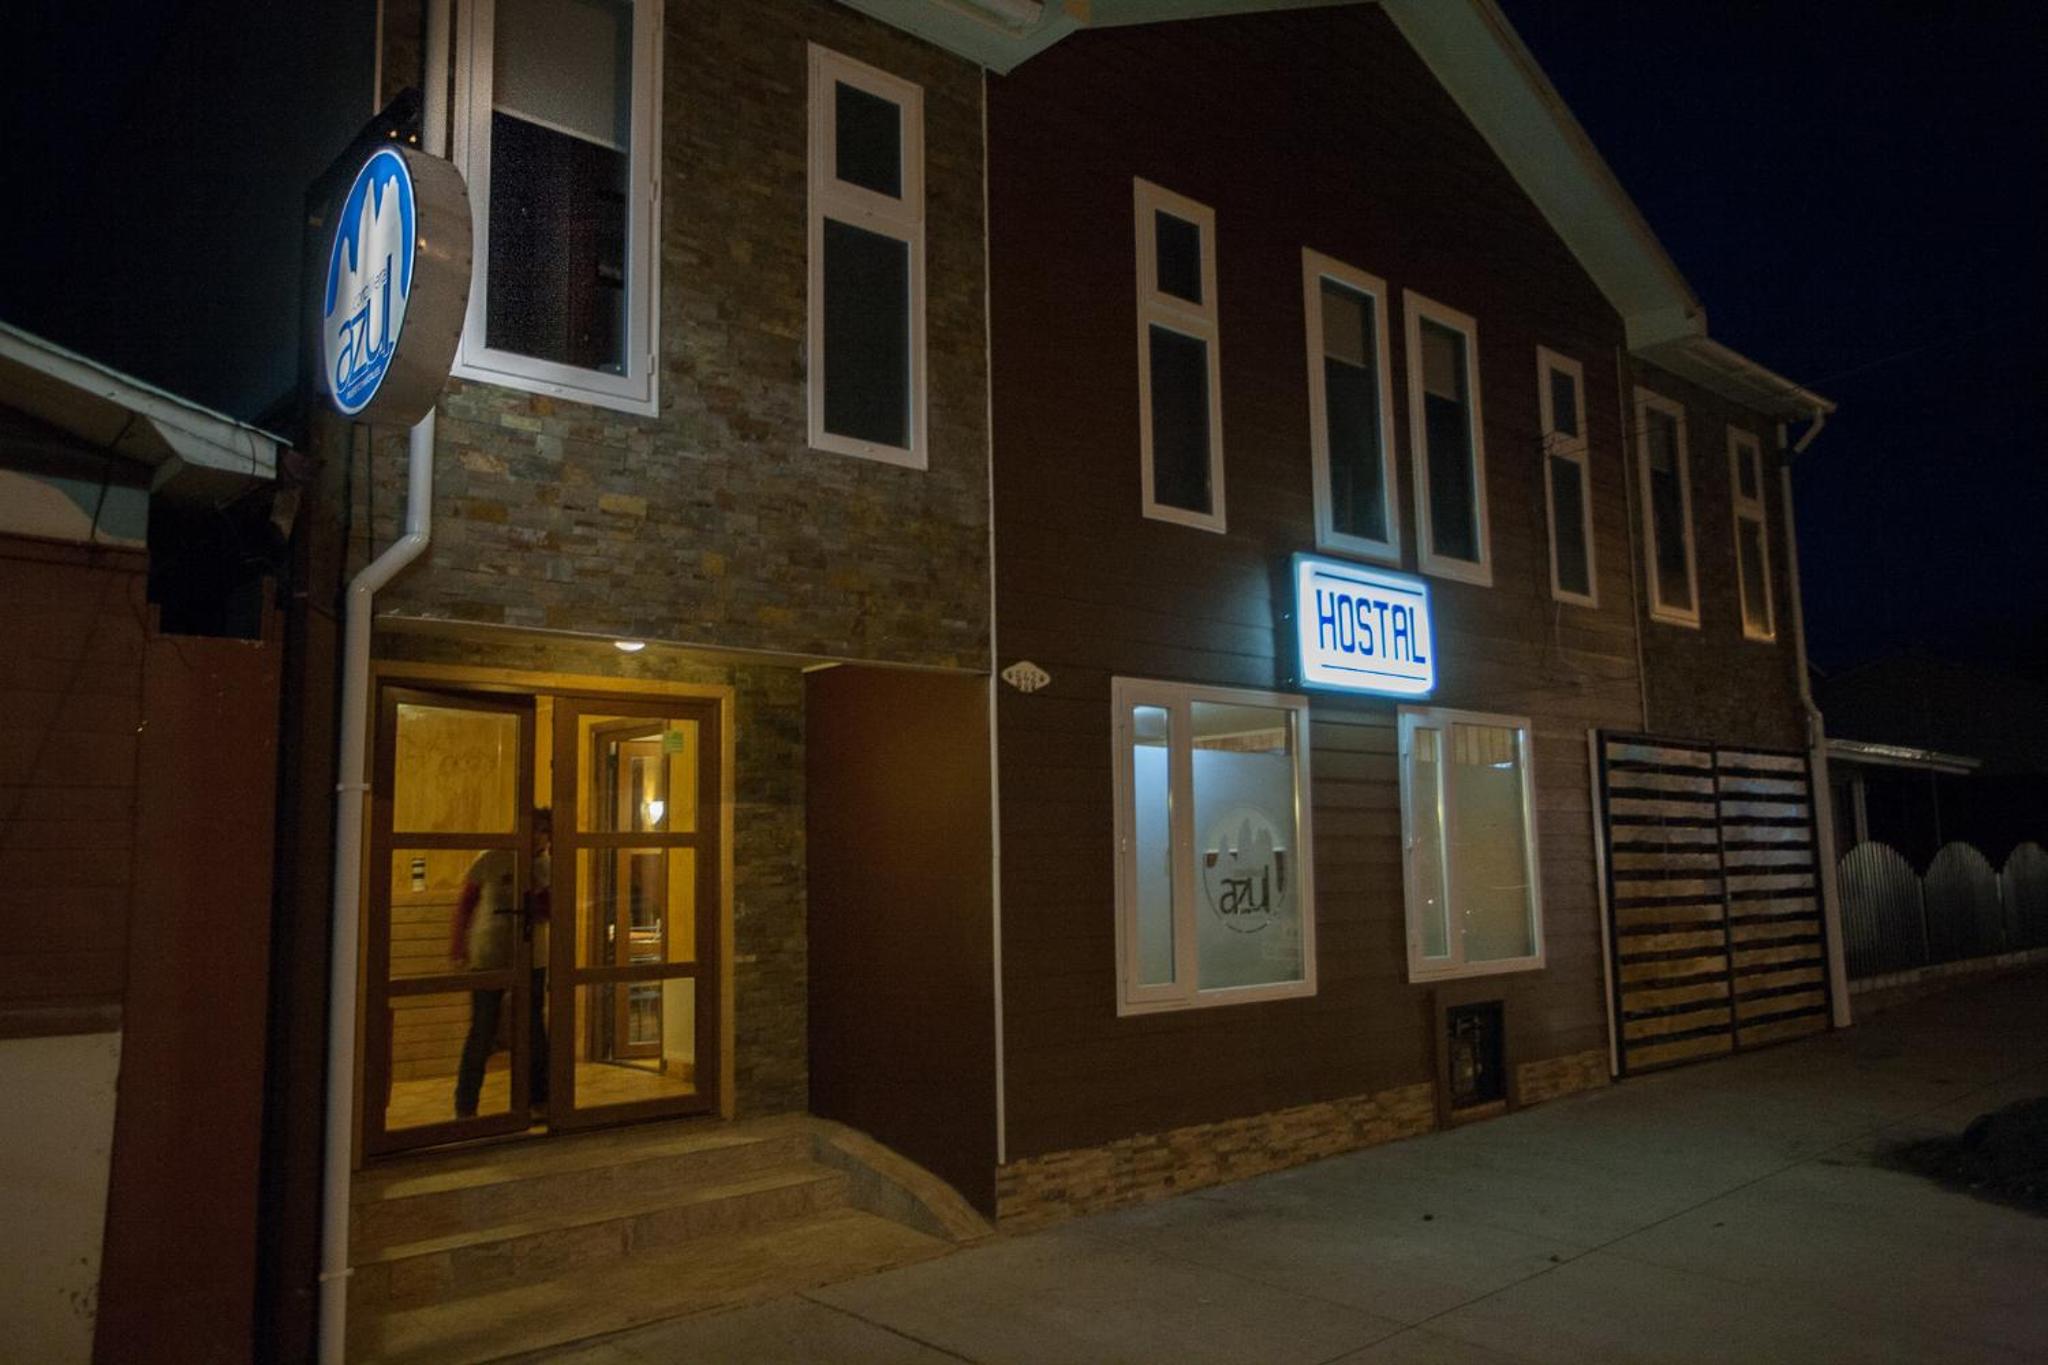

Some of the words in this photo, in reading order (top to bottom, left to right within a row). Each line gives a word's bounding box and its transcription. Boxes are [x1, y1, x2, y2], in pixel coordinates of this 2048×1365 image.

[336, 254, 394, 392] azul
[1316, 589, 1426, 664] HOSTAL
[1220, 864, 1270, 914] azul
